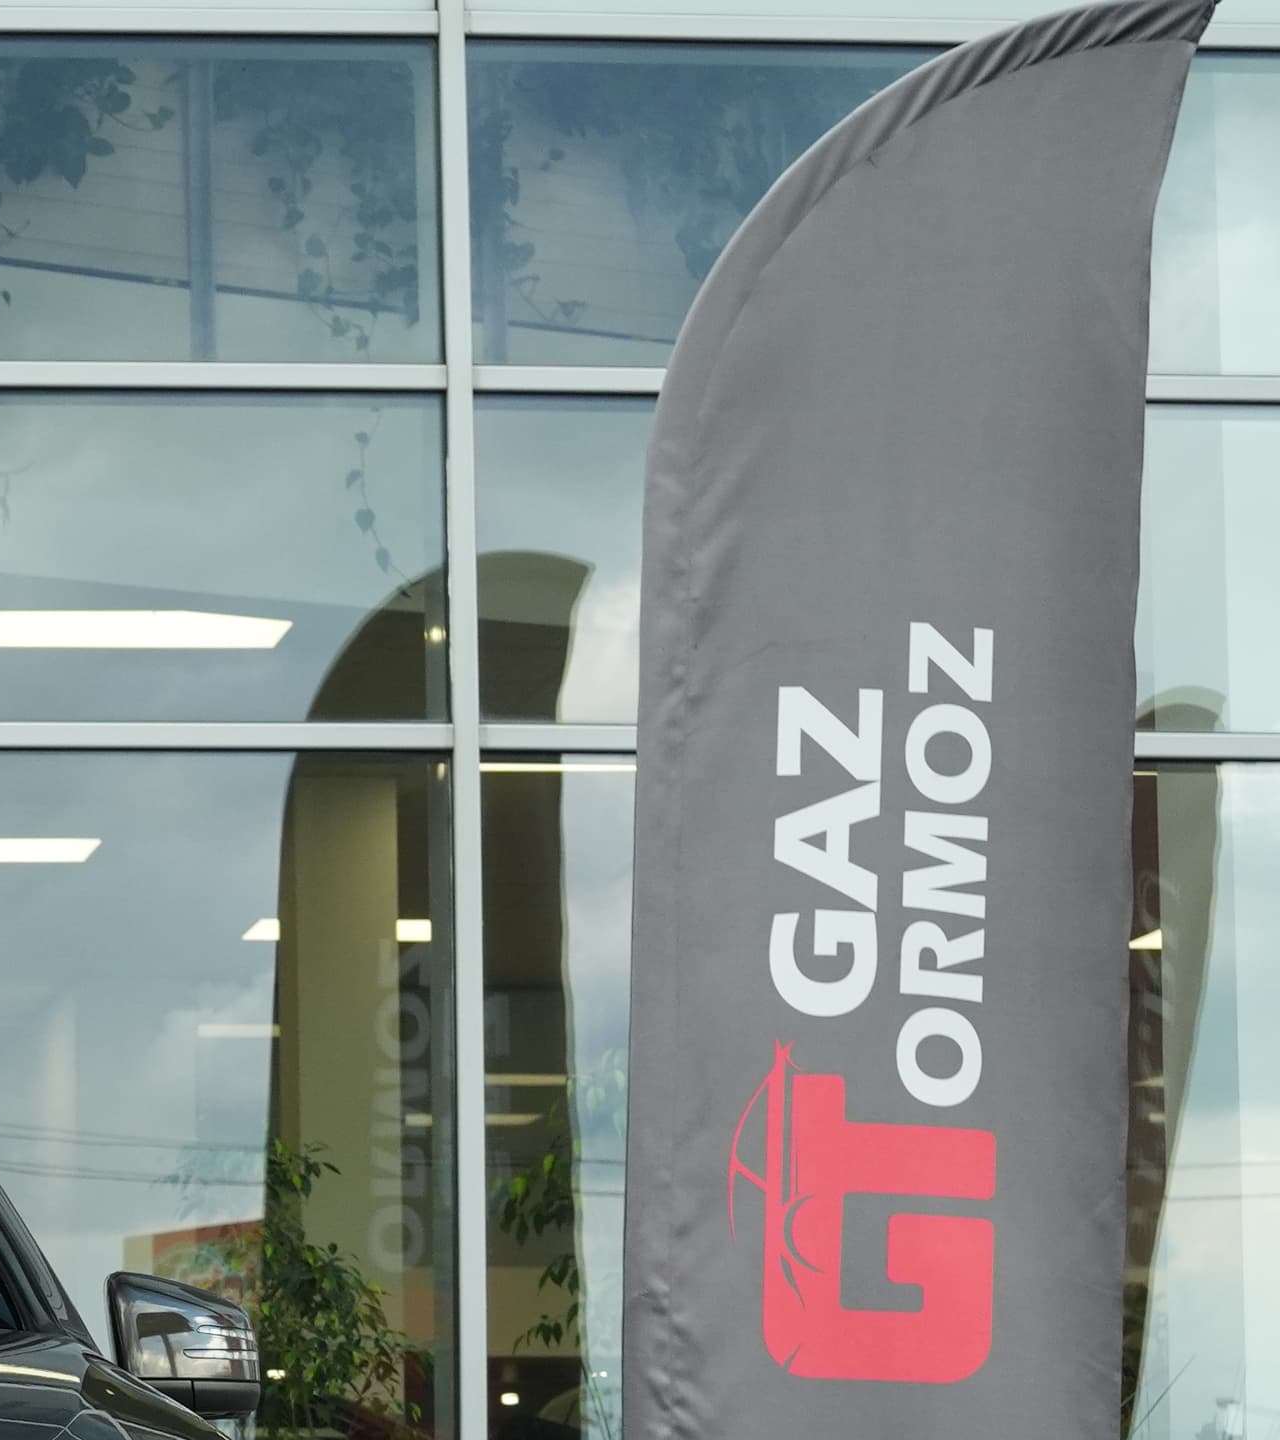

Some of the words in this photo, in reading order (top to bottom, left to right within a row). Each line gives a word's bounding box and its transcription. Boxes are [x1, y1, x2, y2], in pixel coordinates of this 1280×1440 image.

[768, 685, 884, 1017] GAZ
[895, 621, 995, 1108] ORMOZ
[761, 1072, 997, 1385] GT
